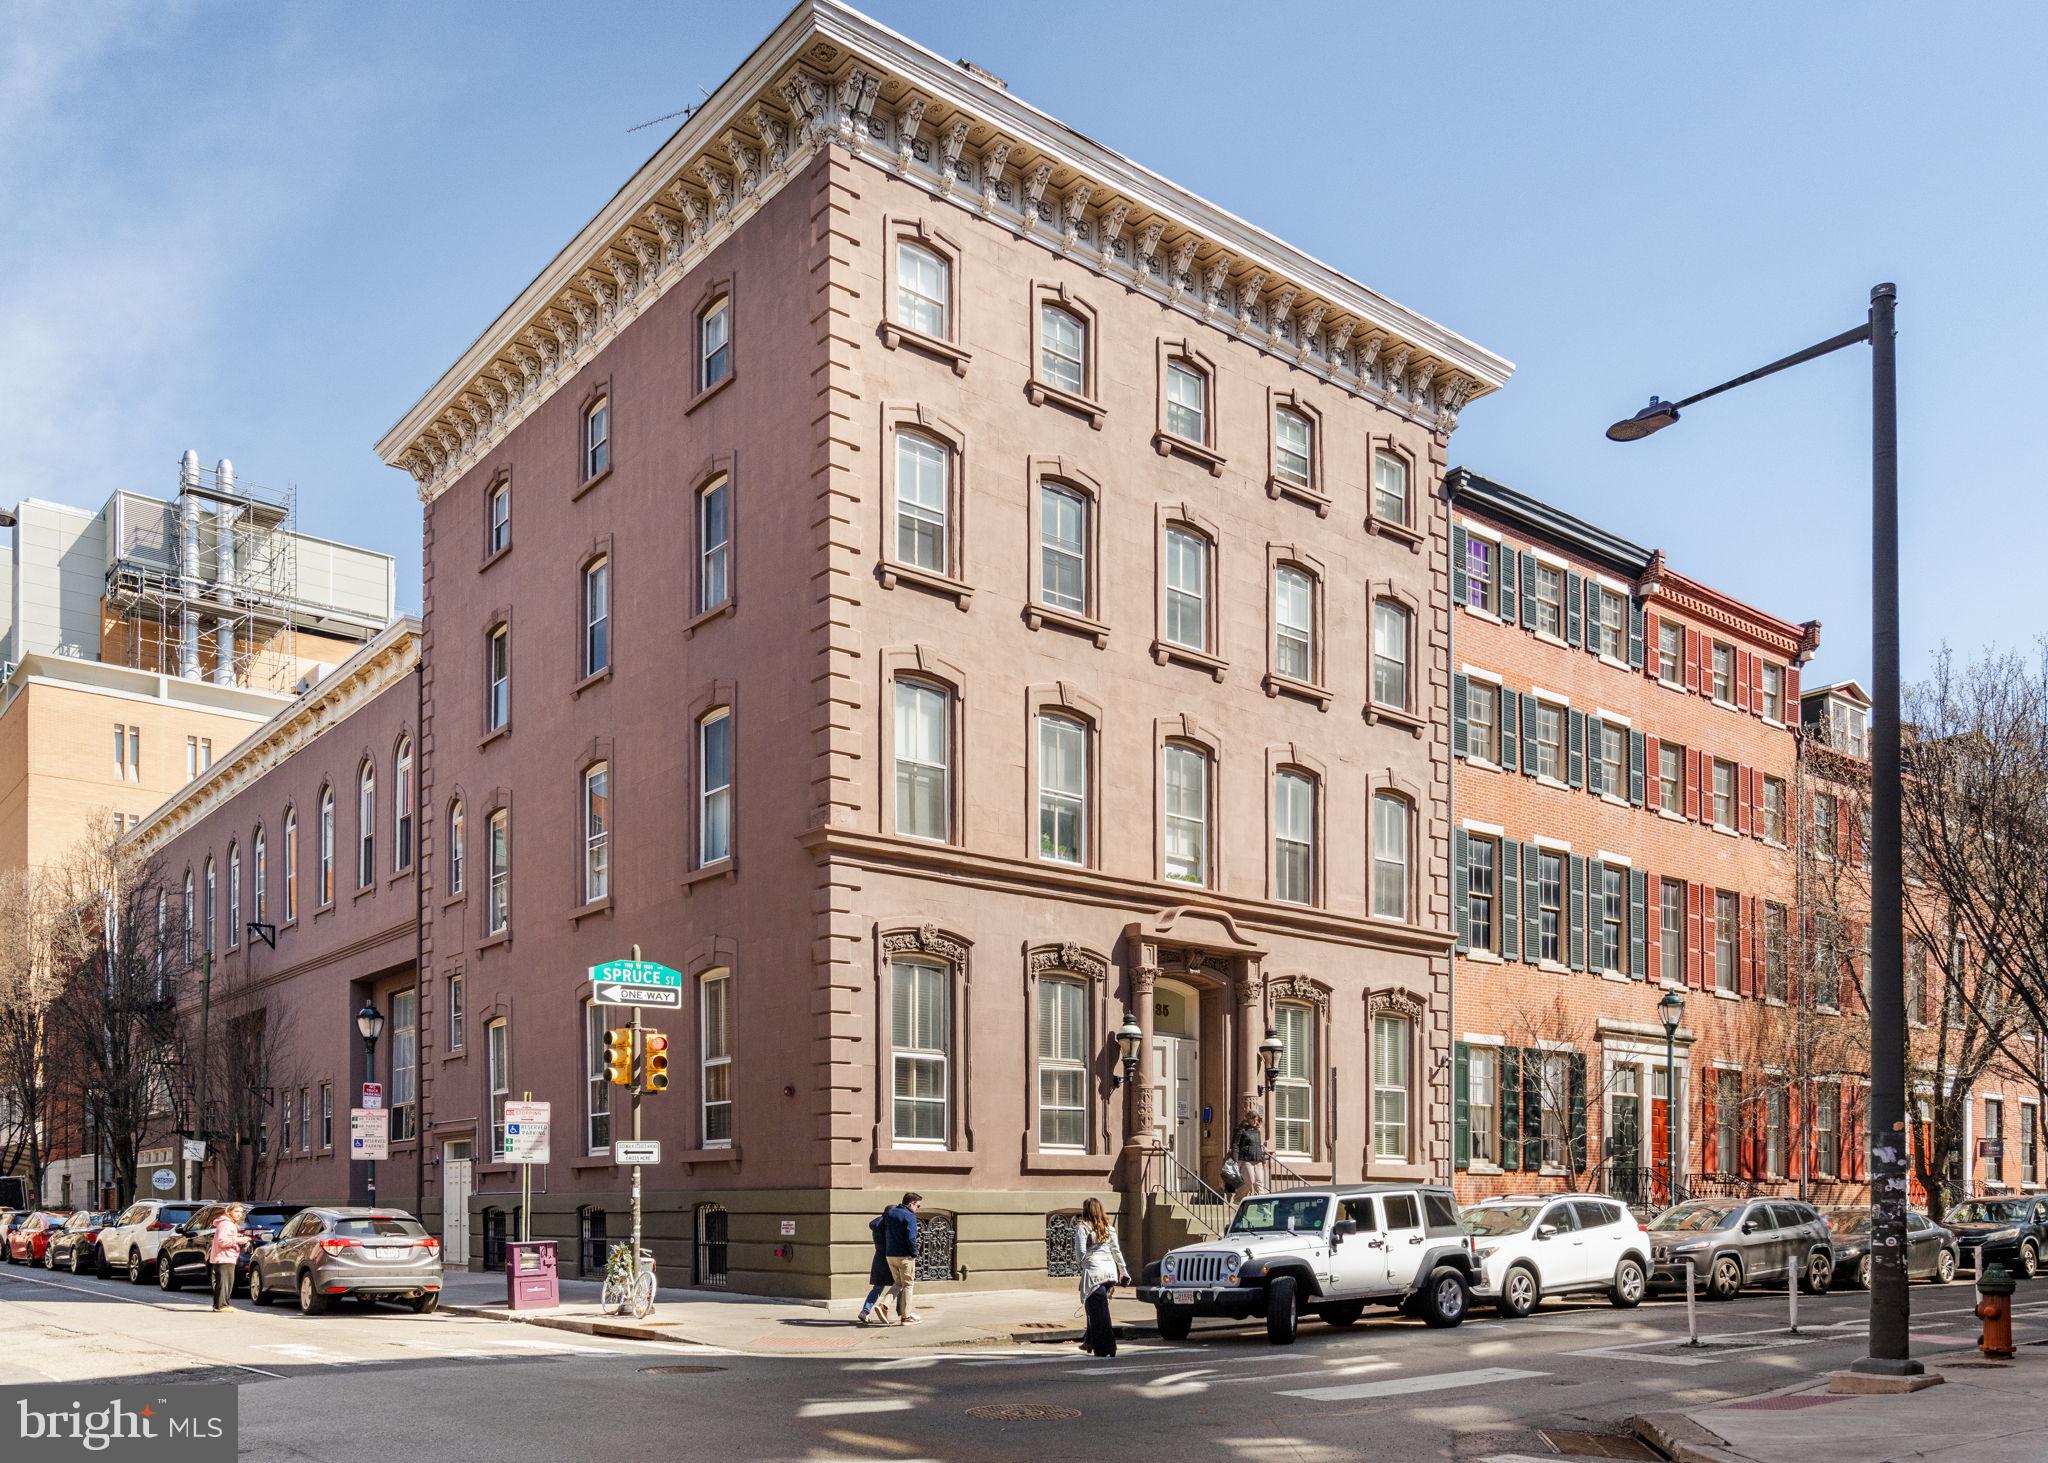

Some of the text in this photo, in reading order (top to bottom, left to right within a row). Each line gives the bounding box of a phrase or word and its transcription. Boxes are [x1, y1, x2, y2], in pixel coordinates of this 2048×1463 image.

[603, 967, 674, 985] SPRUCE ST
[620, 989, 671, 1001] ONE WAY
